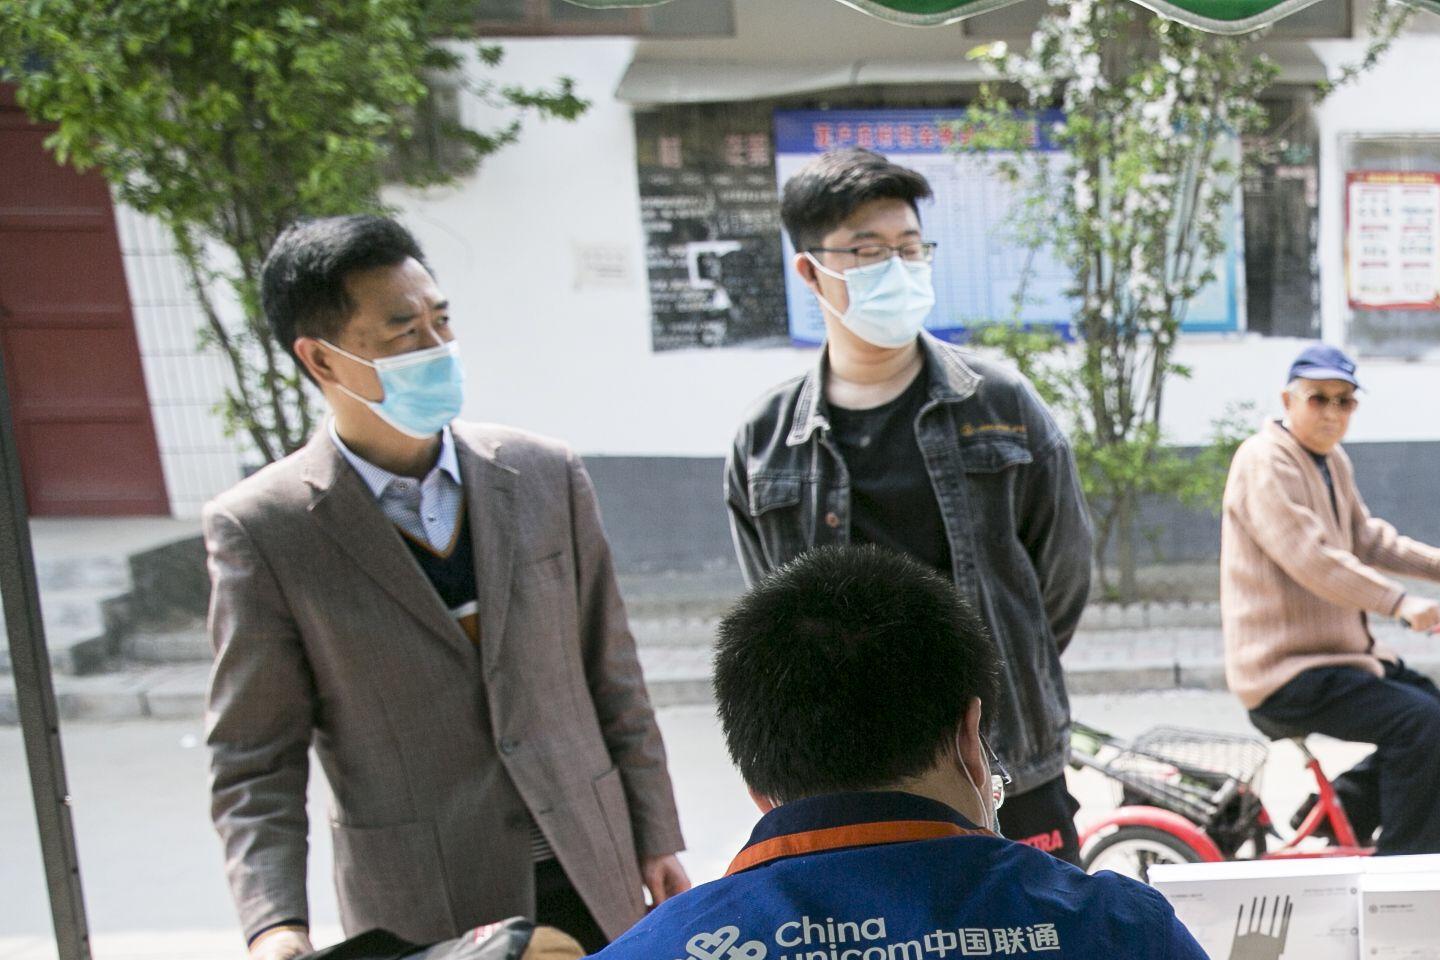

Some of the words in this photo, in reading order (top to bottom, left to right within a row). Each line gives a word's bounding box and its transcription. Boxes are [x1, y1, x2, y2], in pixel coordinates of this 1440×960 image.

[775, 915, 886, 947] China
[923, 923, 1061, 957] 中国联通
